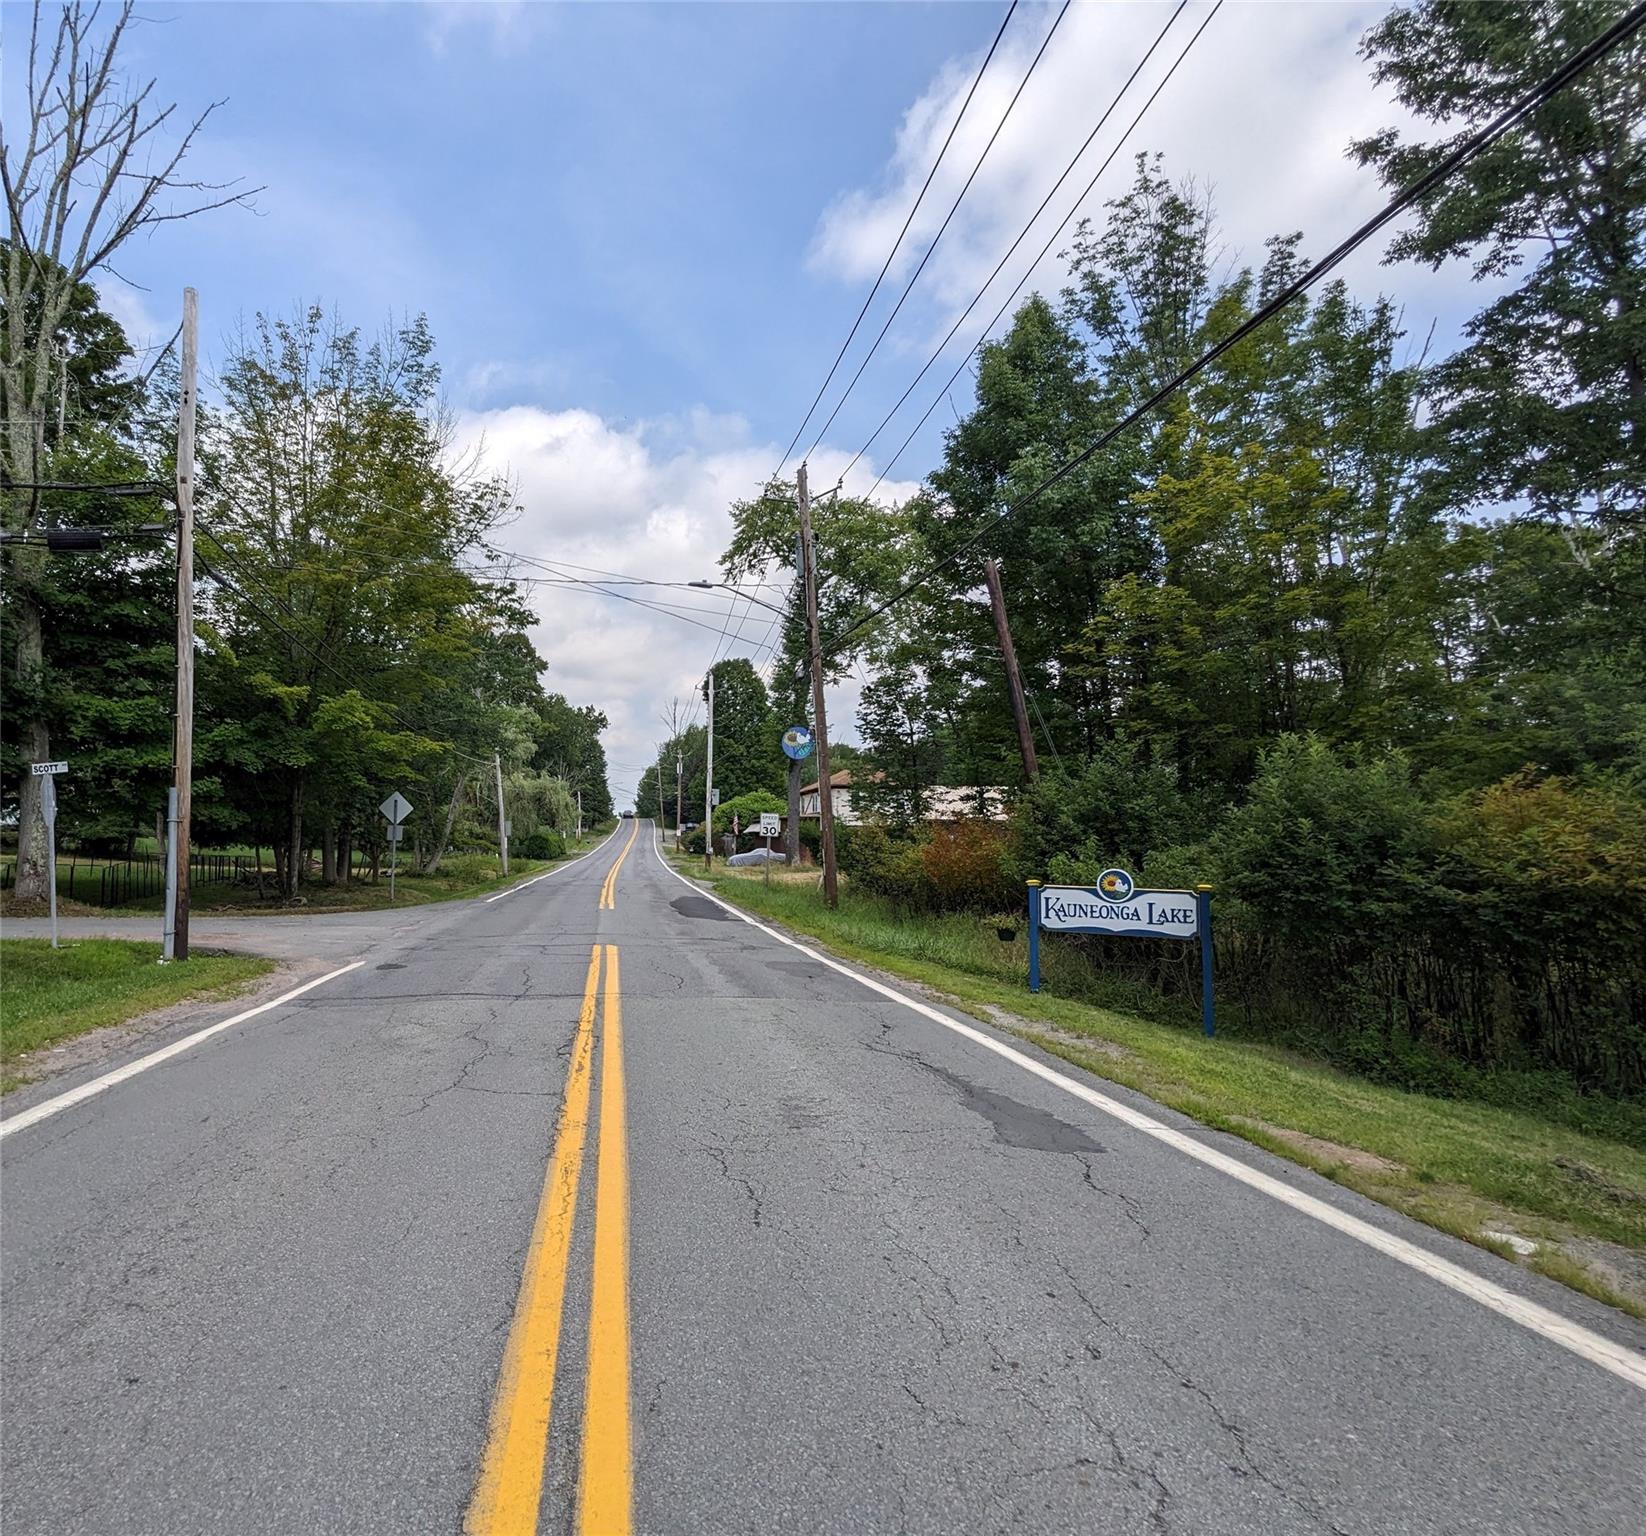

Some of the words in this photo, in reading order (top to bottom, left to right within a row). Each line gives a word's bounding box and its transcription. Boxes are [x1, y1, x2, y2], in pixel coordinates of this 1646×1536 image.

[34, 764, 58, 773] SCOTT
[762, 826, 776, 835] 30
[1044, 897, 1142, 922] KAUNEONGA
[1147, 903, 1194, 925] LAKE
